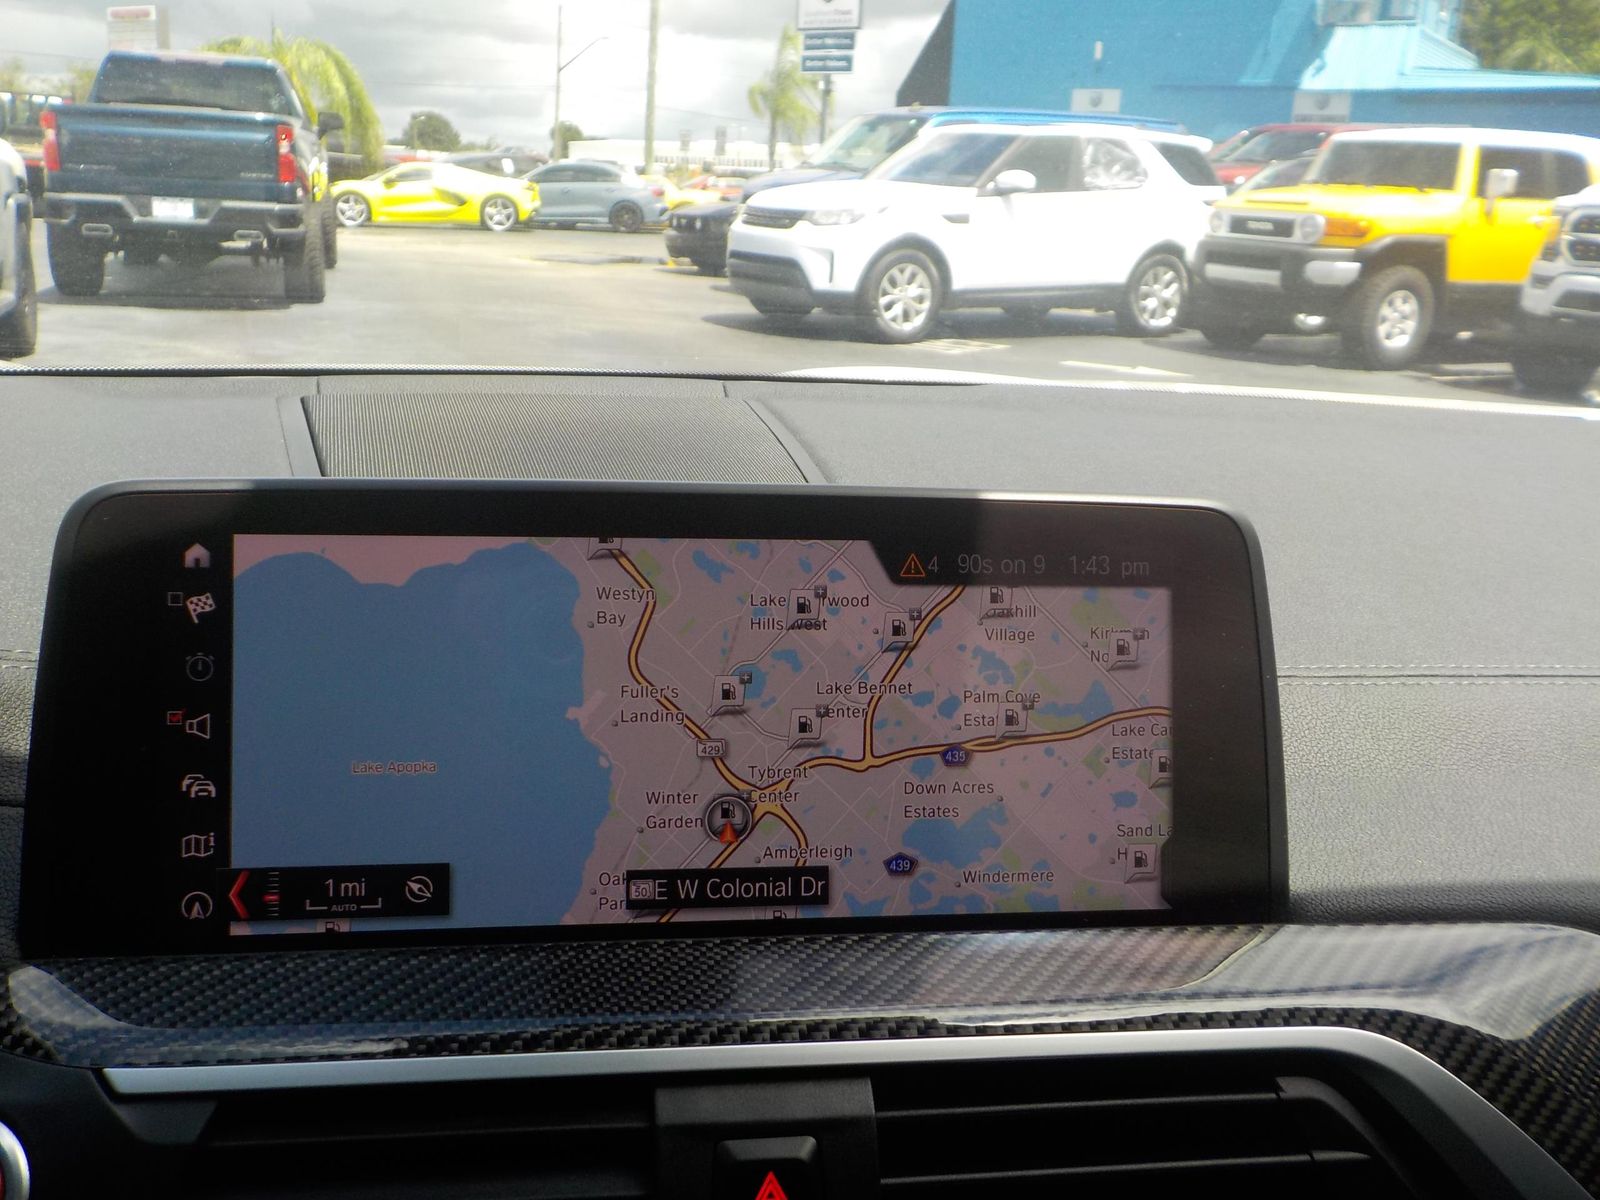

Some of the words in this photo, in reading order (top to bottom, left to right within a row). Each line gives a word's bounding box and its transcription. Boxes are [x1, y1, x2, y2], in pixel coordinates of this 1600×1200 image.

[928, 556, 939, 573] 4
[957, 554, 993, 574] 90s
[1001, 559, 1026, 574] on
[1033, 555, 1046, 574] 9
[1069, 555, 1110, 575] 1:43
[1121, 560, 1149, 579] pm
[596, 587, 655, 603] Westyn
[750, 594, 786, 607] Lake
[596, 611, 626, 627] Bay
[750, 618, 784, 630] Hills
[985, 628, 1035, 643] Village
[620, 685, 679, 698] Fuller's
[816, 682, 852, 695] Lake
[858, 682, 913, 695] Bennet
[963, 690, 999, 703] Palm
[1005, 690, 1041, 703] Cove
[620, 710, 685, 725] Landing
[825, 706, 868, 718] enter
[1111, 723, 1146, 736] Lake
[701, 745, 720, 755] 429
[945, 751, 966, 762] 435
[352, 760, 382, 774] Lake
[387, 760, 437, 776] Apopka
[748, 765, 808, 781] Tybrent
[904, 781, 946, 795] Down
[951, 781, 994, 794] Acres
[646, 791, 699, 804] Winter
[749, 790, 800, 803] Center
[904, 805, 959, 818] Estates
[646, 815, 703, 829] Garden
[1117, 824, 1152, 837] Sand
[763, 845, 853, 860] Amberleigh
[889, 859, 911, 872] 439
[963, 870, 1054, 883] Windermere
[324, 878, 334, 897] 1
[341, 878, 366, 897] mi
[634, 887, 648, 897] 50
[655, 880, 668, 900] E
[677, 879, 699, 899] W
[706, 877, 791, 899] Colonial
[801, 876, 826, 897] Dr
[330, 903, 357, 912] AUTO
[599, 897, 625, 910] Par
